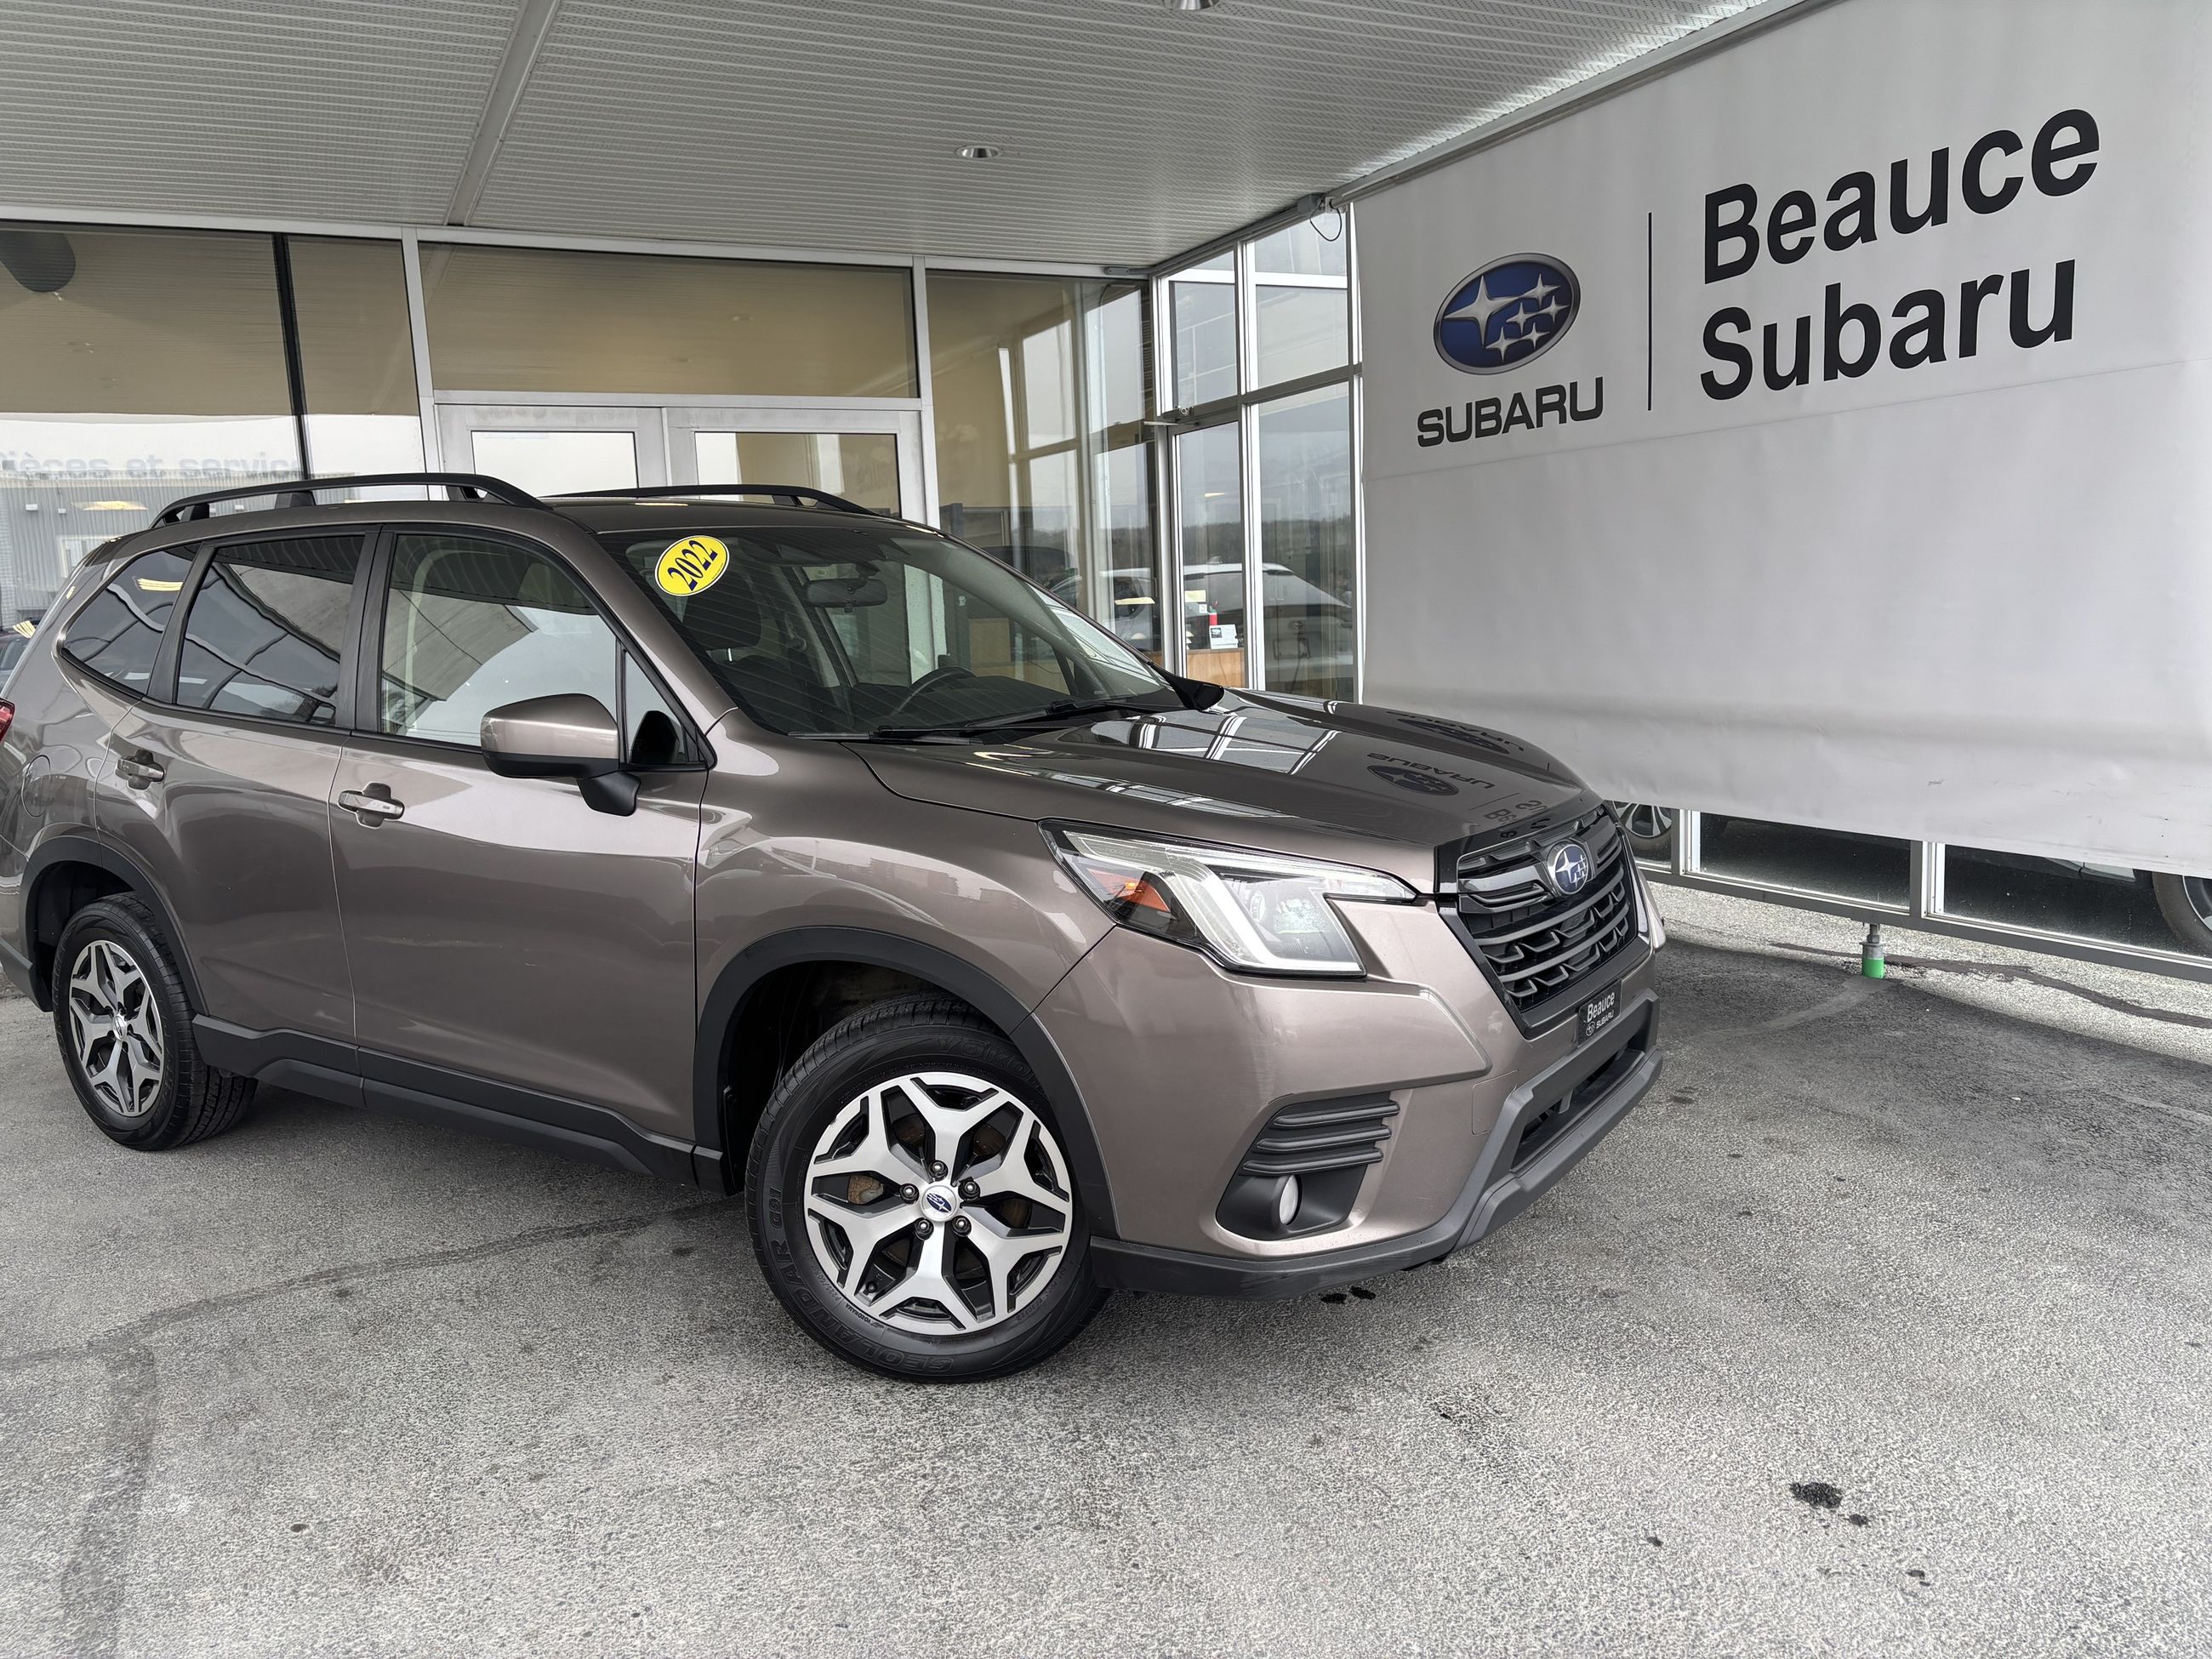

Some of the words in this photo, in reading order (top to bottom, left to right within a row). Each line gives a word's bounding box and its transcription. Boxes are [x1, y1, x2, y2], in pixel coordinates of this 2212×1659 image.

[1704, 109, 2100, 284] Beauce
[1701, 259, 2076, 400] Subaru
[1417, 377, 1604, 448] SUBARU
[127, 452, 164, 478] et
[179, 450, 299, 478] servic
[668, 540, 718, 591] 2022
[1587, 991, 1615, 1023] Beauce
[1596, 1009, 1615, 1029] SUBARU
[937, 1035, 1040, 1086] YOKO
[768, 1185, 783, 1229] G91
[771, 1239, 954, 1372] GEOLANDAR
[845, 1303, 871, 1325] YOKOHAMA
